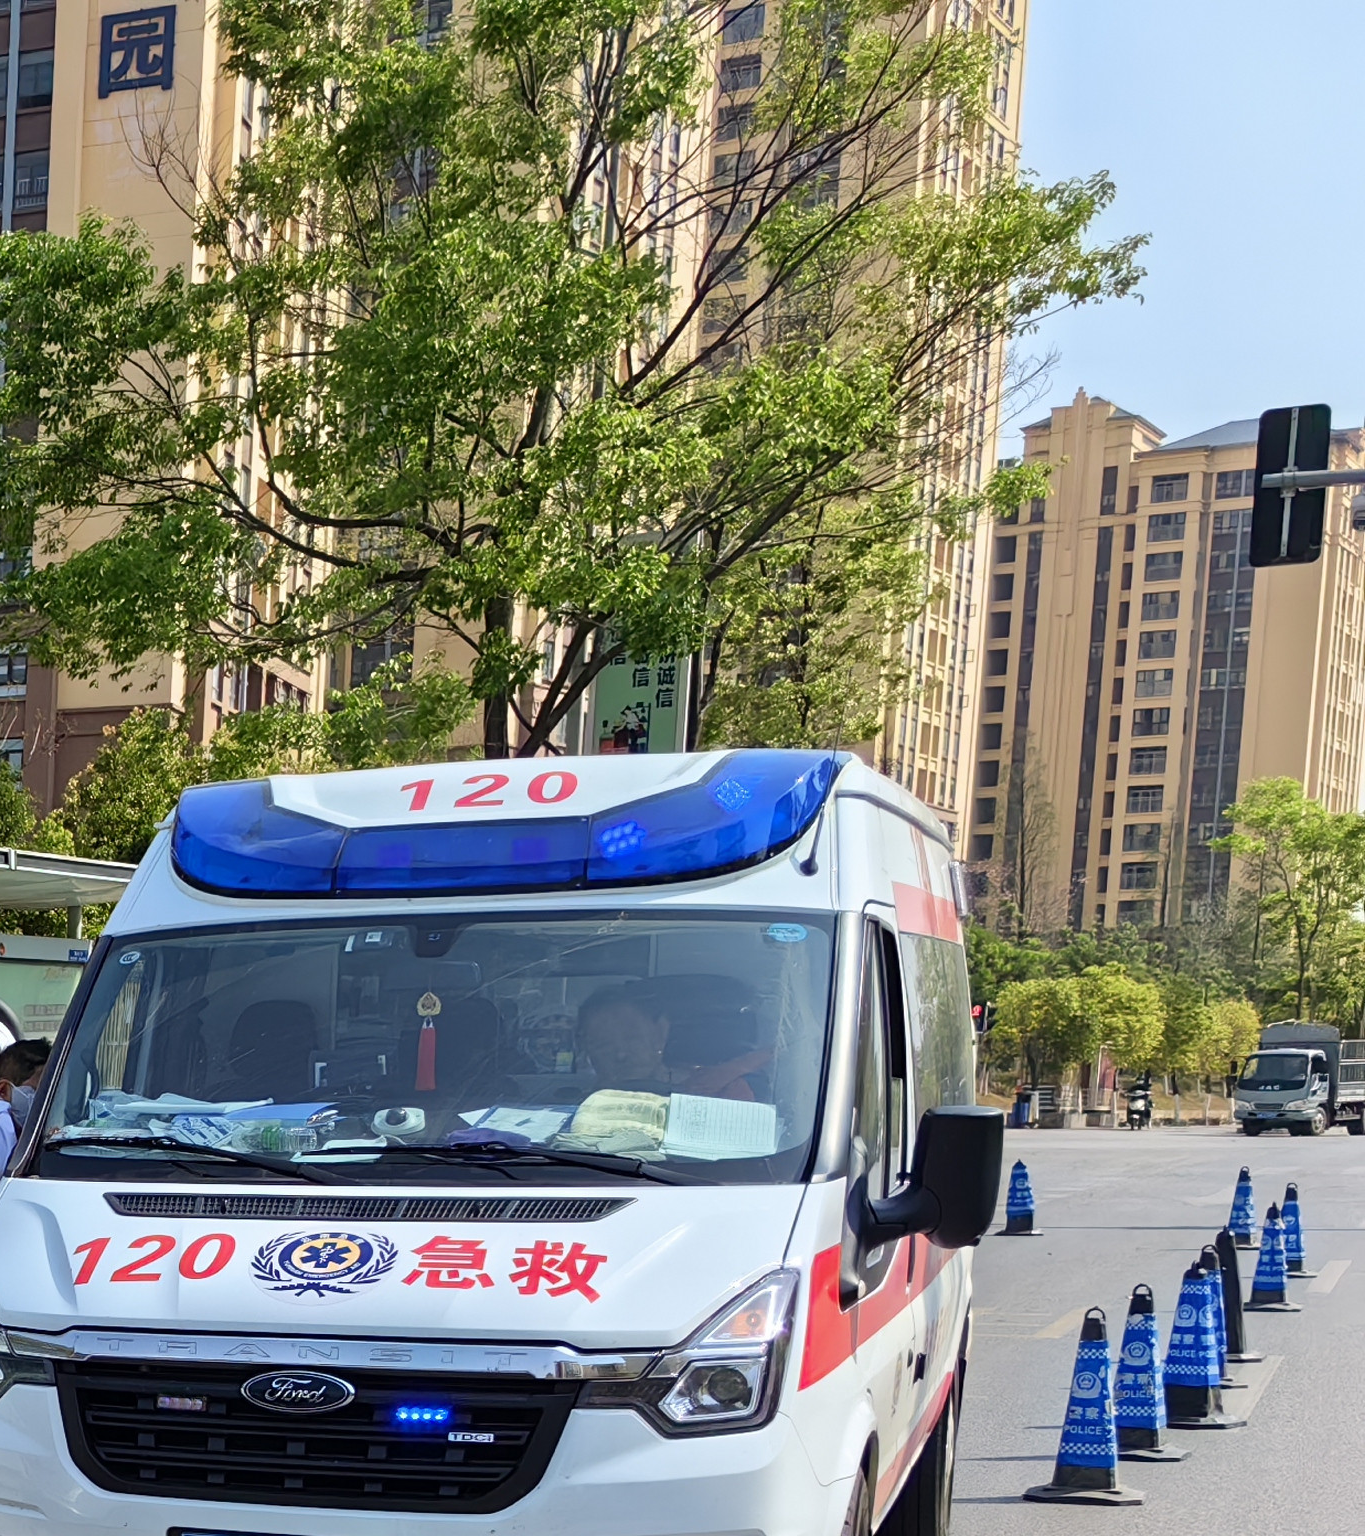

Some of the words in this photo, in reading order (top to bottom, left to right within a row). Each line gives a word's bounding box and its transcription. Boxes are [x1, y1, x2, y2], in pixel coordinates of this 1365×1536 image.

[98, 5, 176, 99] 园
[400, 771, 578, 811] 120
[72, 1232, 236, 1285] 120
[401, 1235, 608, 1304] 急救
[96, 1337, 528, 1371] TRANSIT
[264, 1377, 327, 1403] Ford
[1069, 1406, 1099, 1419] 警察
